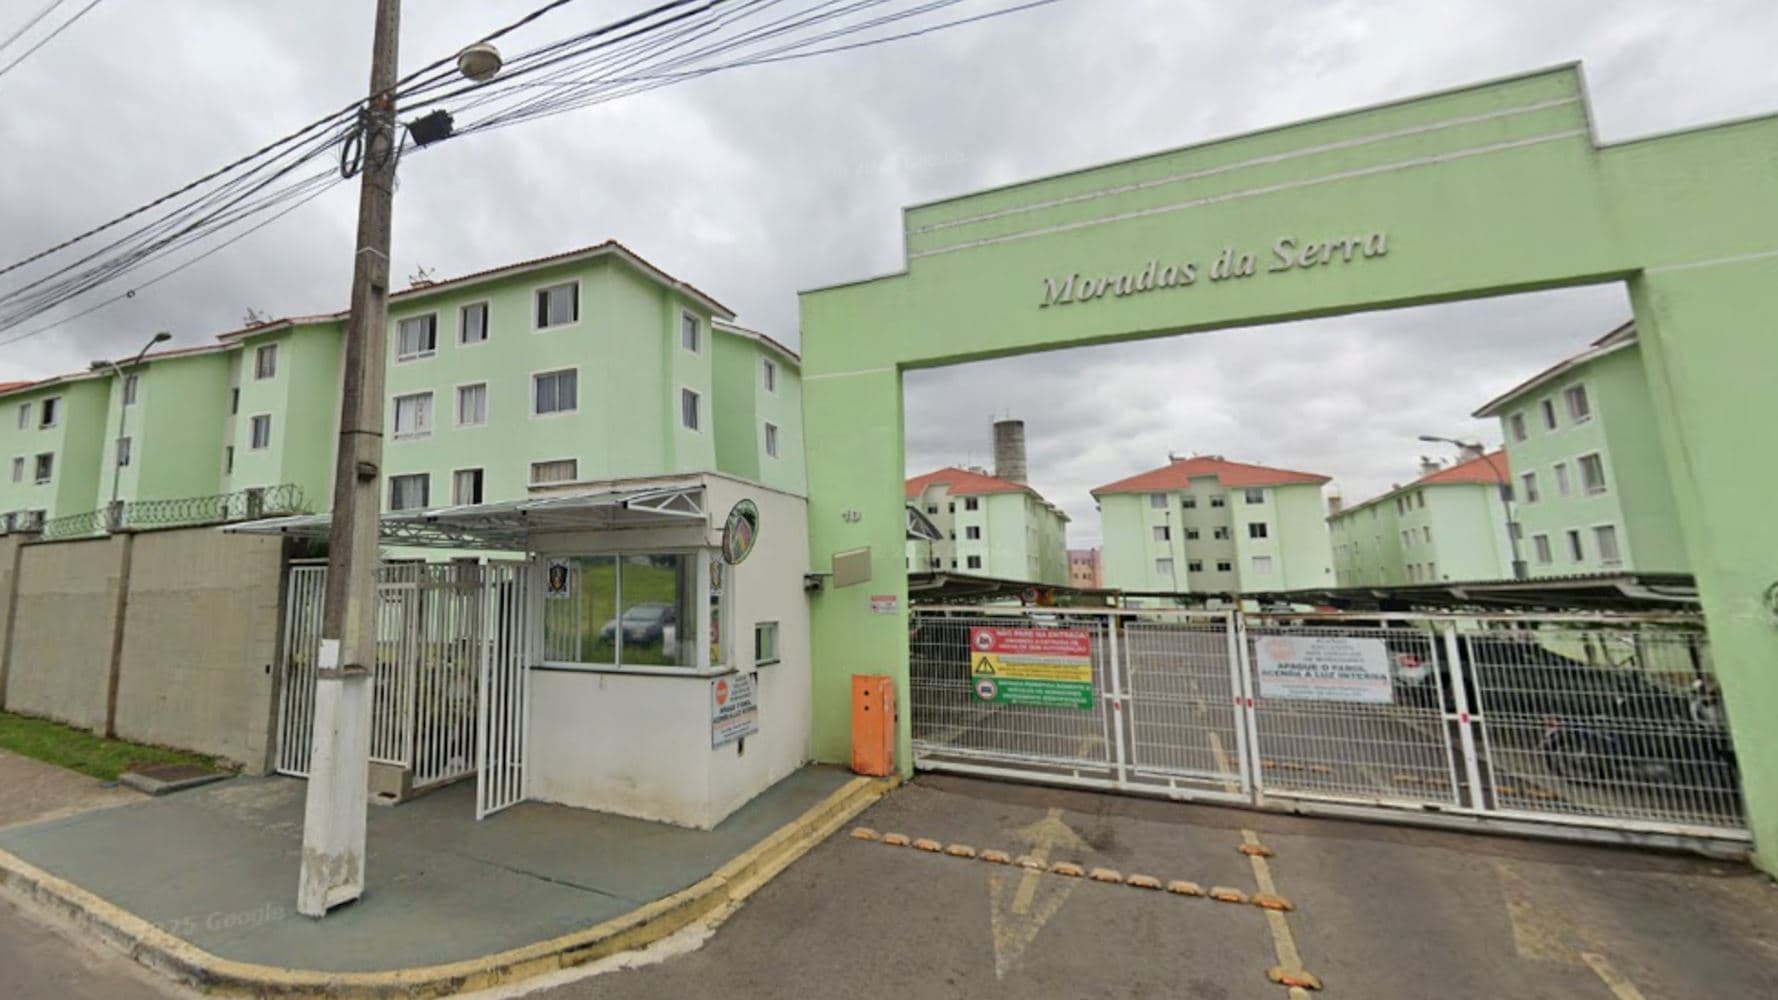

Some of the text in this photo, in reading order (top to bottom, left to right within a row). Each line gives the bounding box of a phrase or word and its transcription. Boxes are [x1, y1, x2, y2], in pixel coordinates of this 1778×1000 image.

[1038, 229, 1389, 309] Moradas da Serra
[1314, 671, 1335, 679] LUZ
